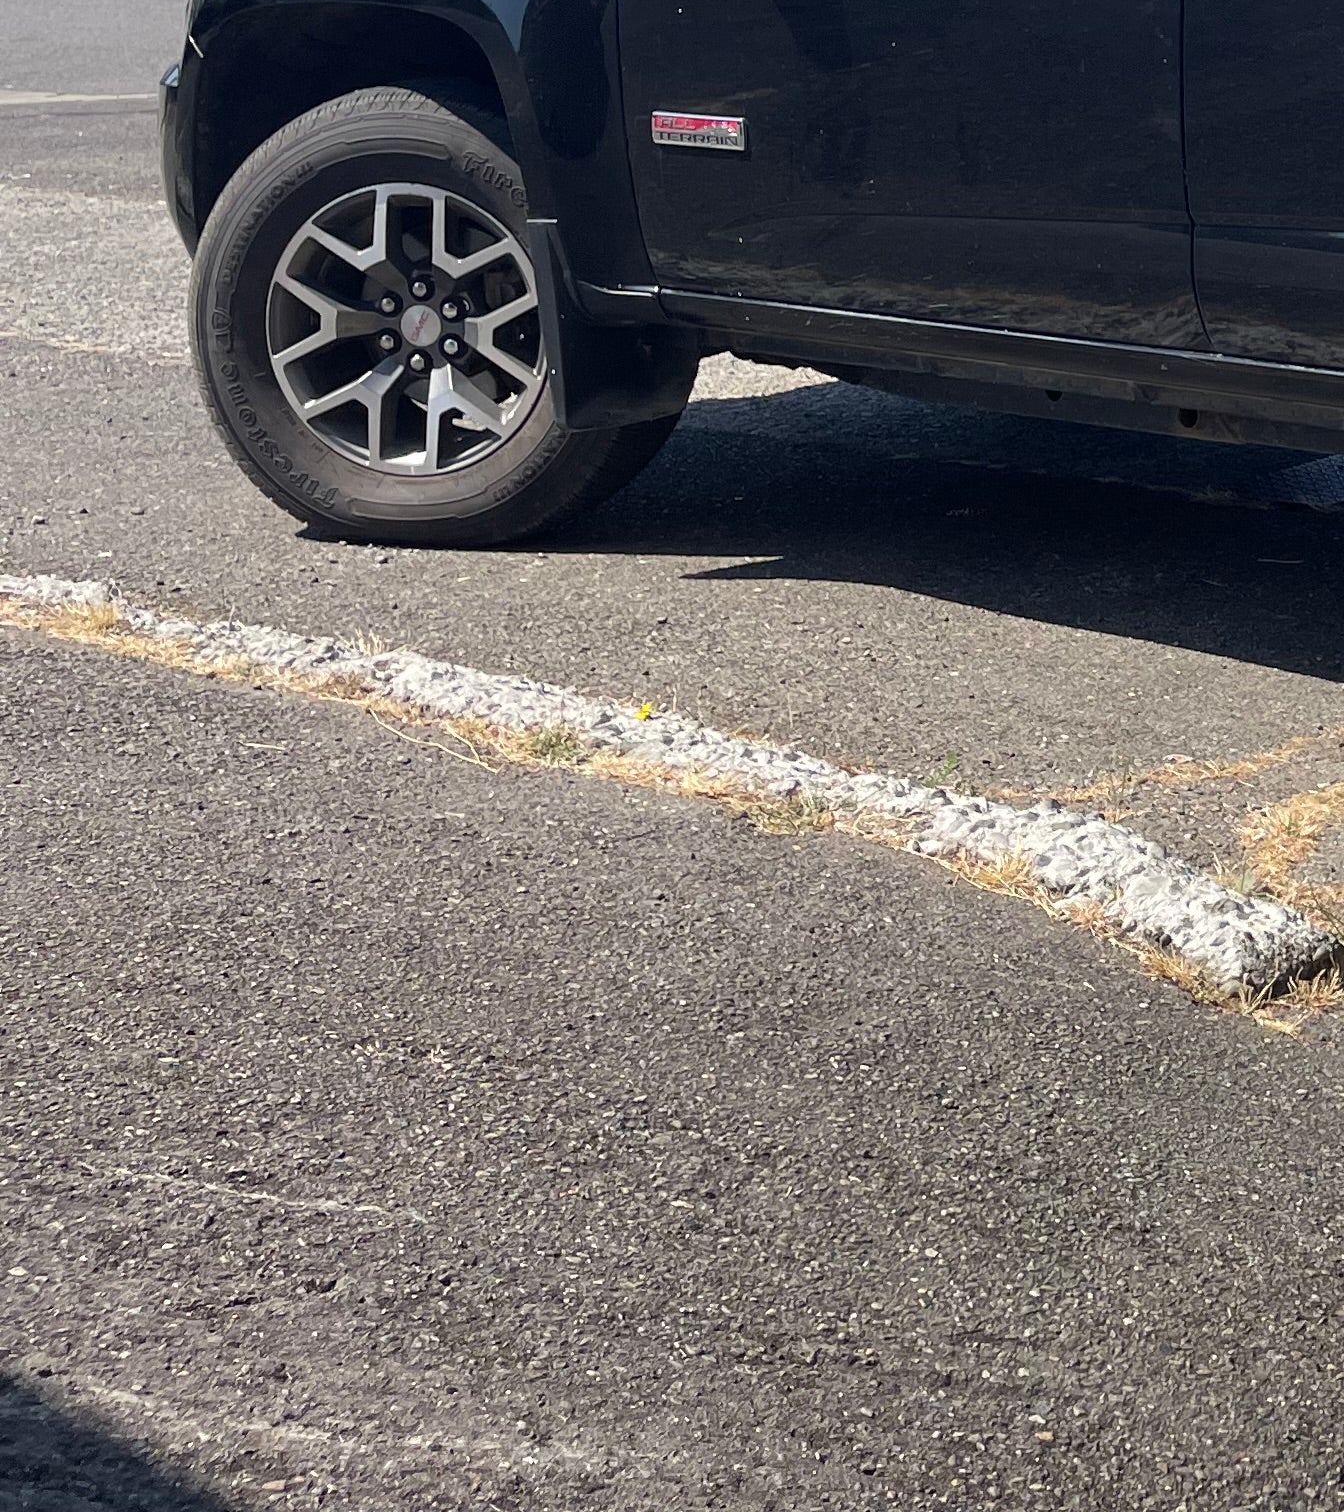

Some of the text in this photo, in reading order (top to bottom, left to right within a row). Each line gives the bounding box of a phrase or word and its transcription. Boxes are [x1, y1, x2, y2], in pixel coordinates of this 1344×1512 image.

[660, 117, 697, 130] ALL
[659, 132, 739, 146] TERRAIN
[410, 309, 431, 343] GMC
[220, 361, 340, 509] Firestone
